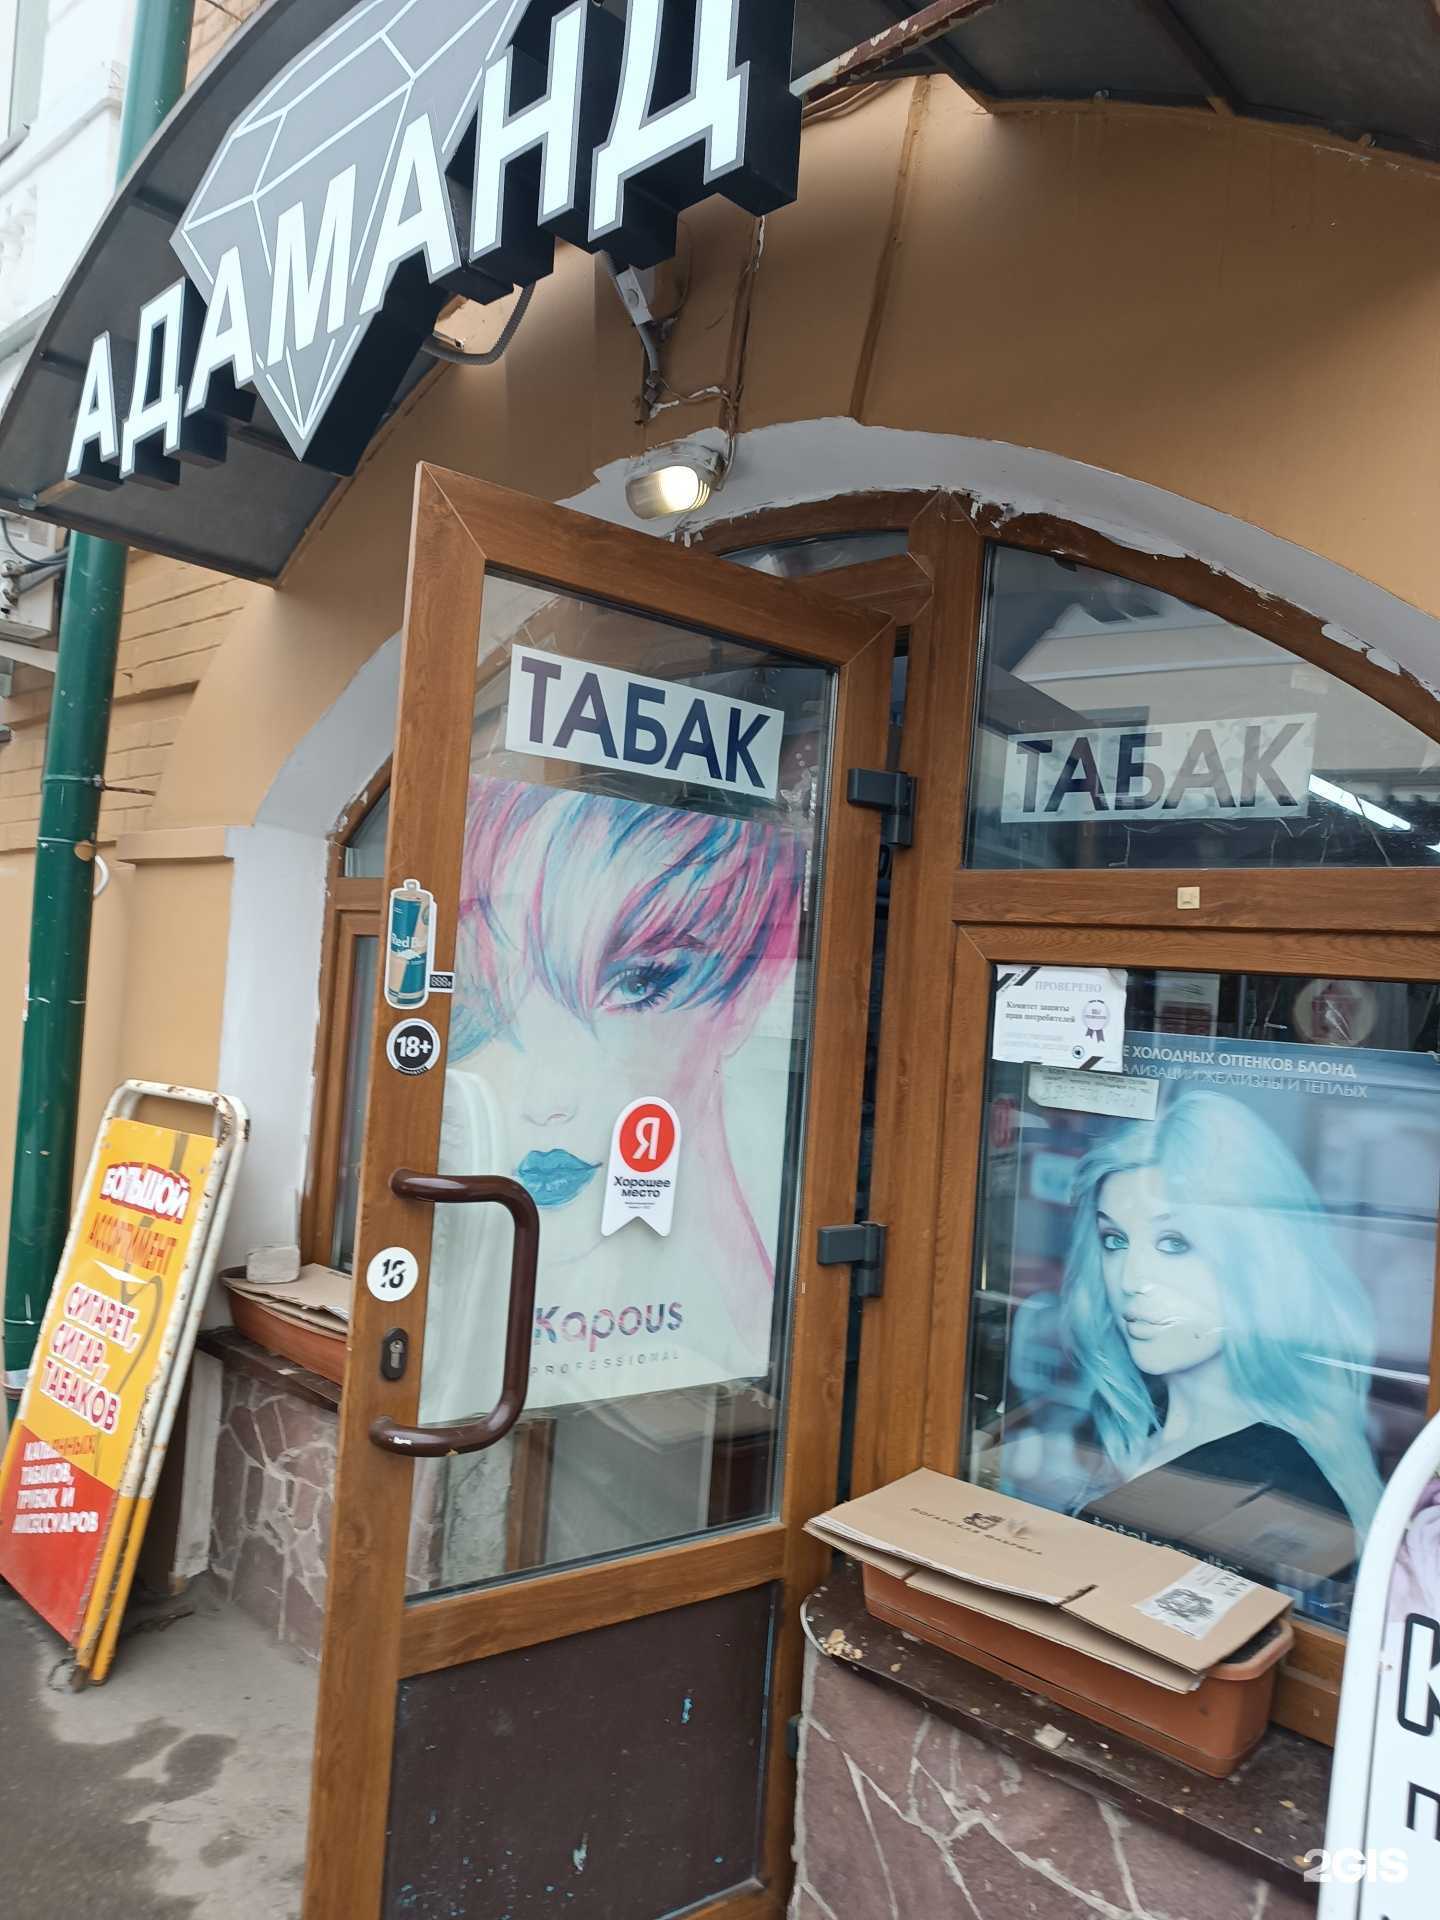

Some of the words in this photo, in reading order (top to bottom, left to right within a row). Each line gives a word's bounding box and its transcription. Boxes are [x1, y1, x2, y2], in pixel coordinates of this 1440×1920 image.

[65, 0, 750, 480] АДАМАНД
[521, 655, 770, 790] ТАБАК
[1015, 721, 1305, 813] ТАБАК
[1006, 1000, 1038, 1010] Комитет
[1035, 981, 1102, 993] ПРОВЕРЕНО
[396, 1035, 432, 1058] 18+
[1132, 1045, 1214, 1066] ХОЛОДНЫХ
[1218, 1053, 1293, 1072] ОТТЕНКОВ
[1298, 1060, 1358, 1079] БЛОНД
[632, 1116, 661, 1160] Я
[101, 1163, 191, 1222] БОЛЬШОЙ
[613, 1175, 671, 1189] Хорошее
[620, 1189, 661, 1198] место
[533, 1301, 683, 1352] Kapous
[40, 1357, 120, 1433] ТАБАКОВ
